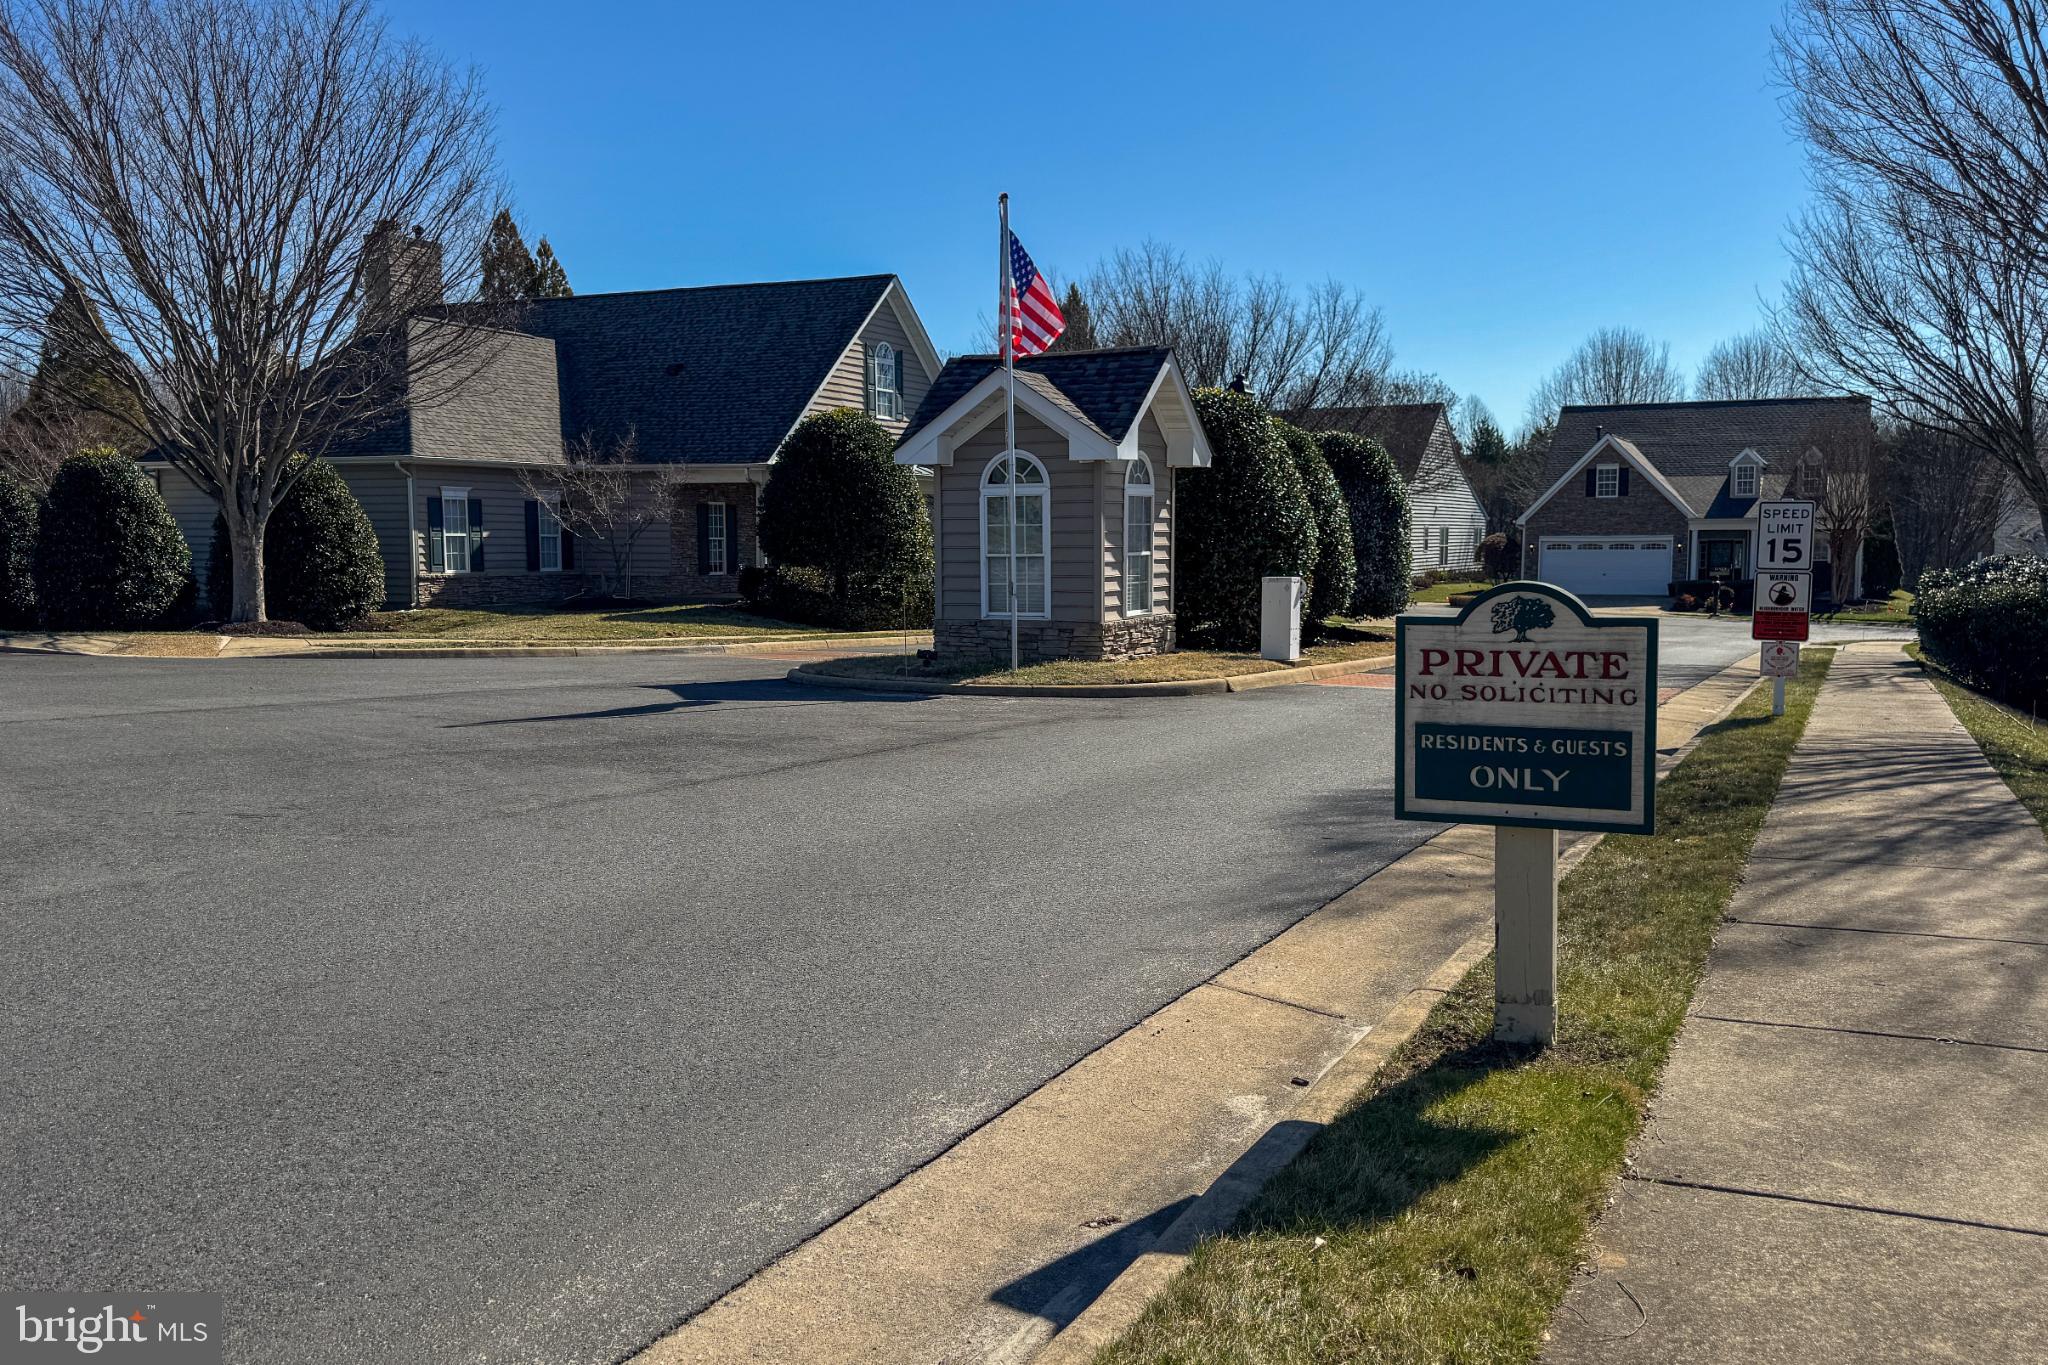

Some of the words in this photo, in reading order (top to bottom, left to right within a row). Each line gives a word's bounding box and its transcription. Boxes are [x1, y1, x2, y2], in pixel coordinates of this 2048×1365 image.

[1763, 508, 1810, 519] SPEED
[1767, 523, 1804, 534] LIMIT
[1766, 538, 1803, 563] 15
[1769, 574, 1799, 582] WARNING
[1418, 648, 1629, 680] PRIVATE
[1410, 684, 1448, 700] NO
[1461, 685, 1639, 706] SOLICITING
[1420, 734, 1529, 753] RESIDENTS
[1533, 739, 1547, 754] &
[1551, 739, 1628, 757] GUESTS
[1469, 765, 1571, 792] ONLY
